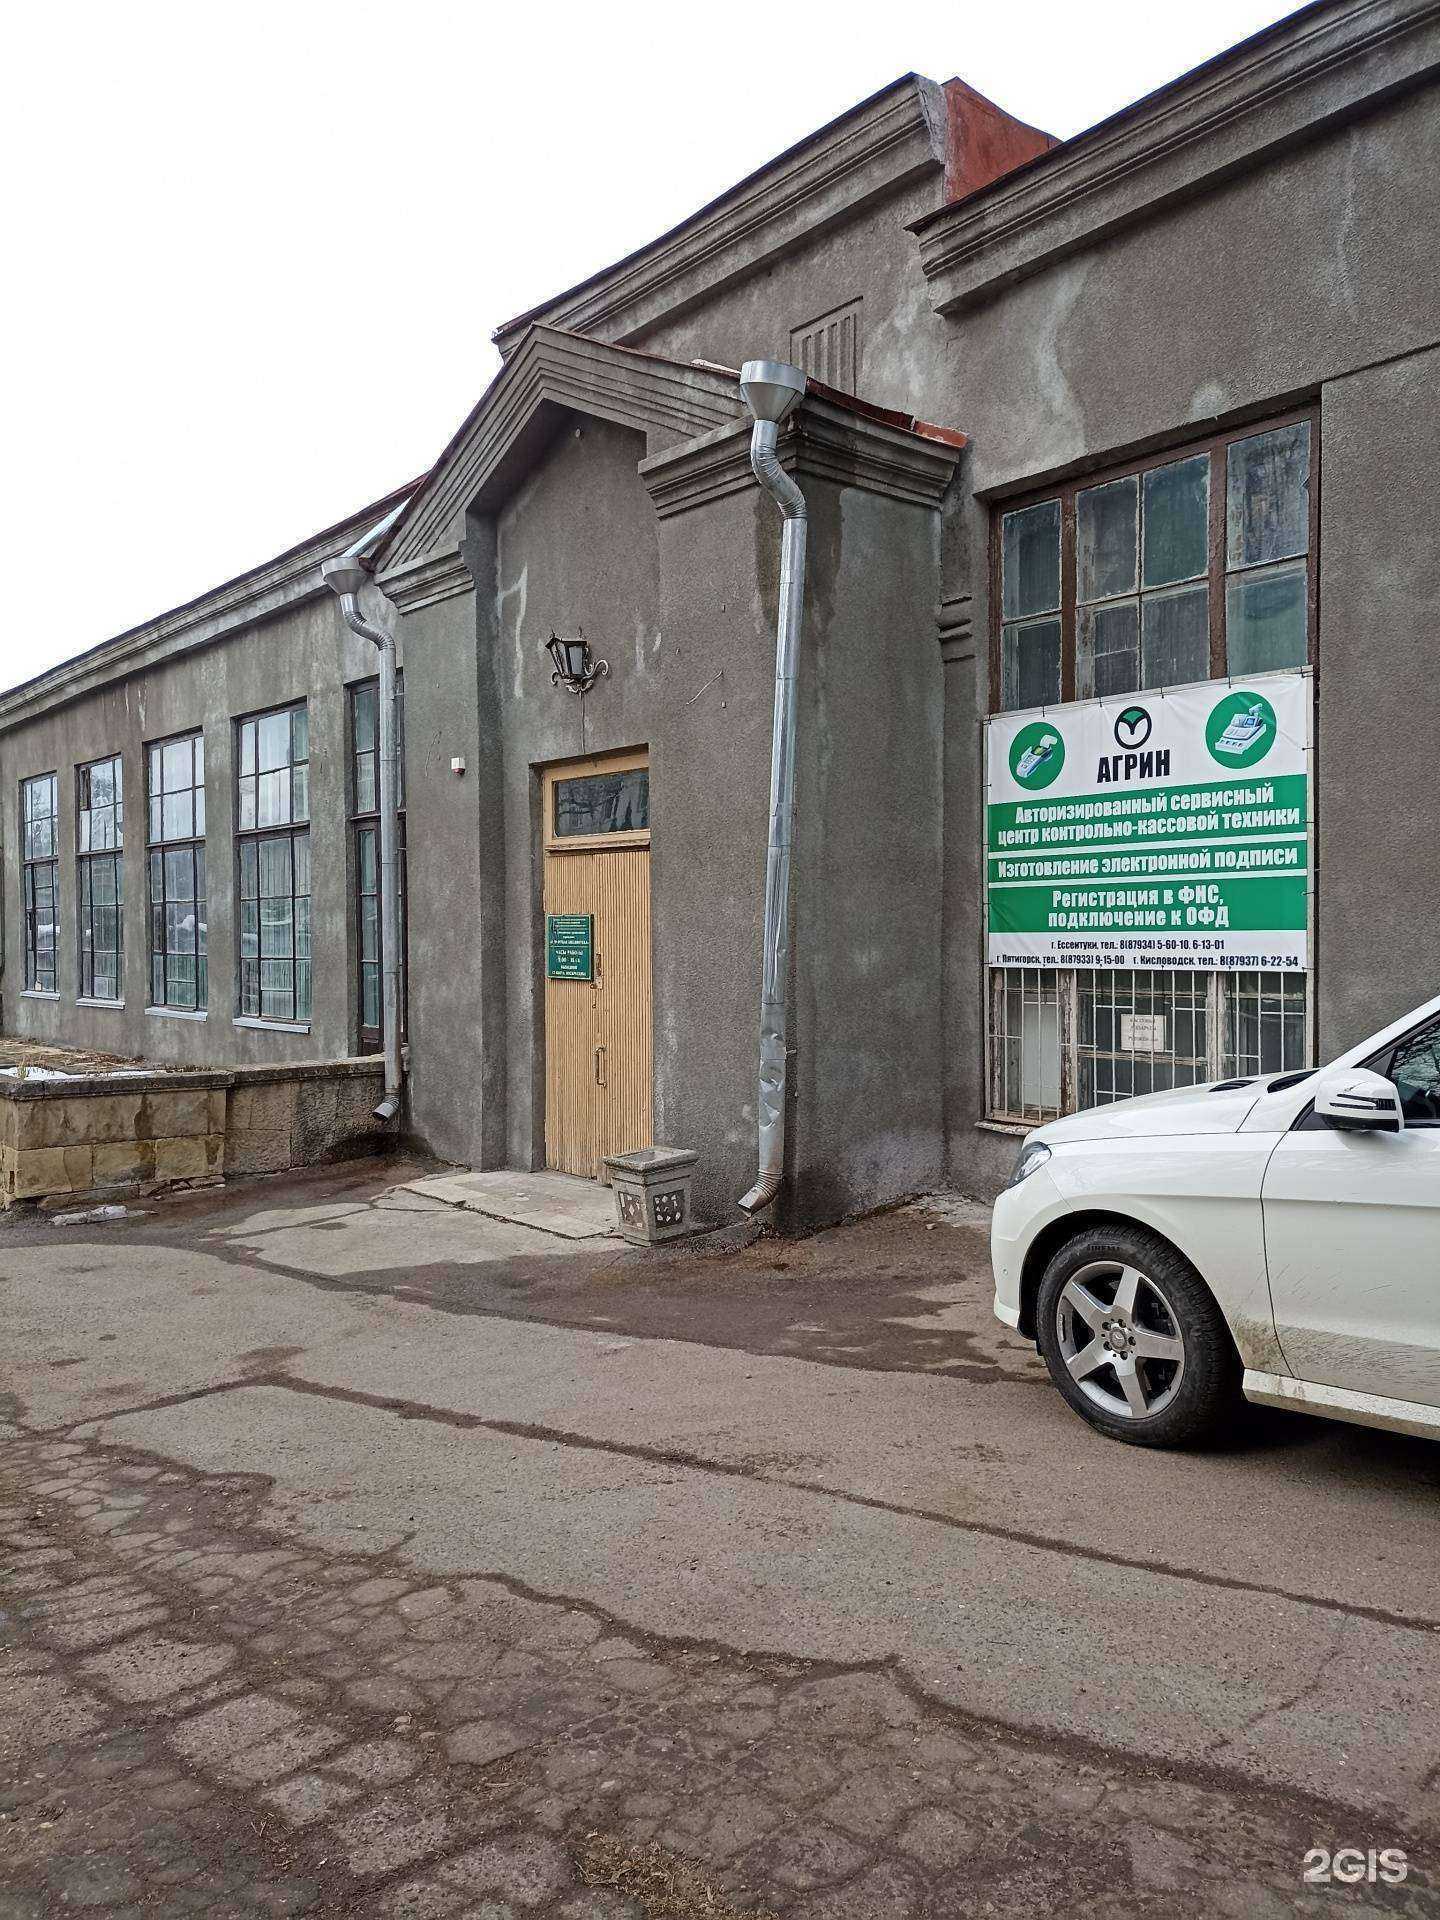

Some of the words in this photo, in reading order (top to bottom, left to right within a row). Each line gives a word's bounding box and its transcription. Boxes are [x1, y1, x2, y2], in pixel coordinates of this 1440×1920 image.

[1097, 749, 1170, 783] АГРИН
[1015, 793, 1167, 824] Авторизированный
[1171, 783, 1274, 811] сервисный
[999, 829, 1039, 846] центр
[1042, 811, 1219, 842] контрольно-кассовой
[1223, 808, 1300, 829] техники
[998, 858, 1098, 878] Изготовление
[1102, 849, 1211, 873] электронной
[1215, 848, 1298, 869] подписи
[1053, 890, 1158, 909] Регистрация
[1164, 890, 1173, 904] в
[1179, 885, 1224, 905] ФНС,
[1048, 910, 1166, 929] подключение
[1171, 910, 1181, 925] к
[1187, 907, 1230, 927] ОФД
[1119, 939, 1156, 950] 8(87934)
[1192, 939, 1225, 950] 6-13-01
[1095, 955, 1125, 965] 9-15-00
[1219, 955, 1259, 967] 8(87937)
[1261, 956, 1299, 967] 6-22-54
